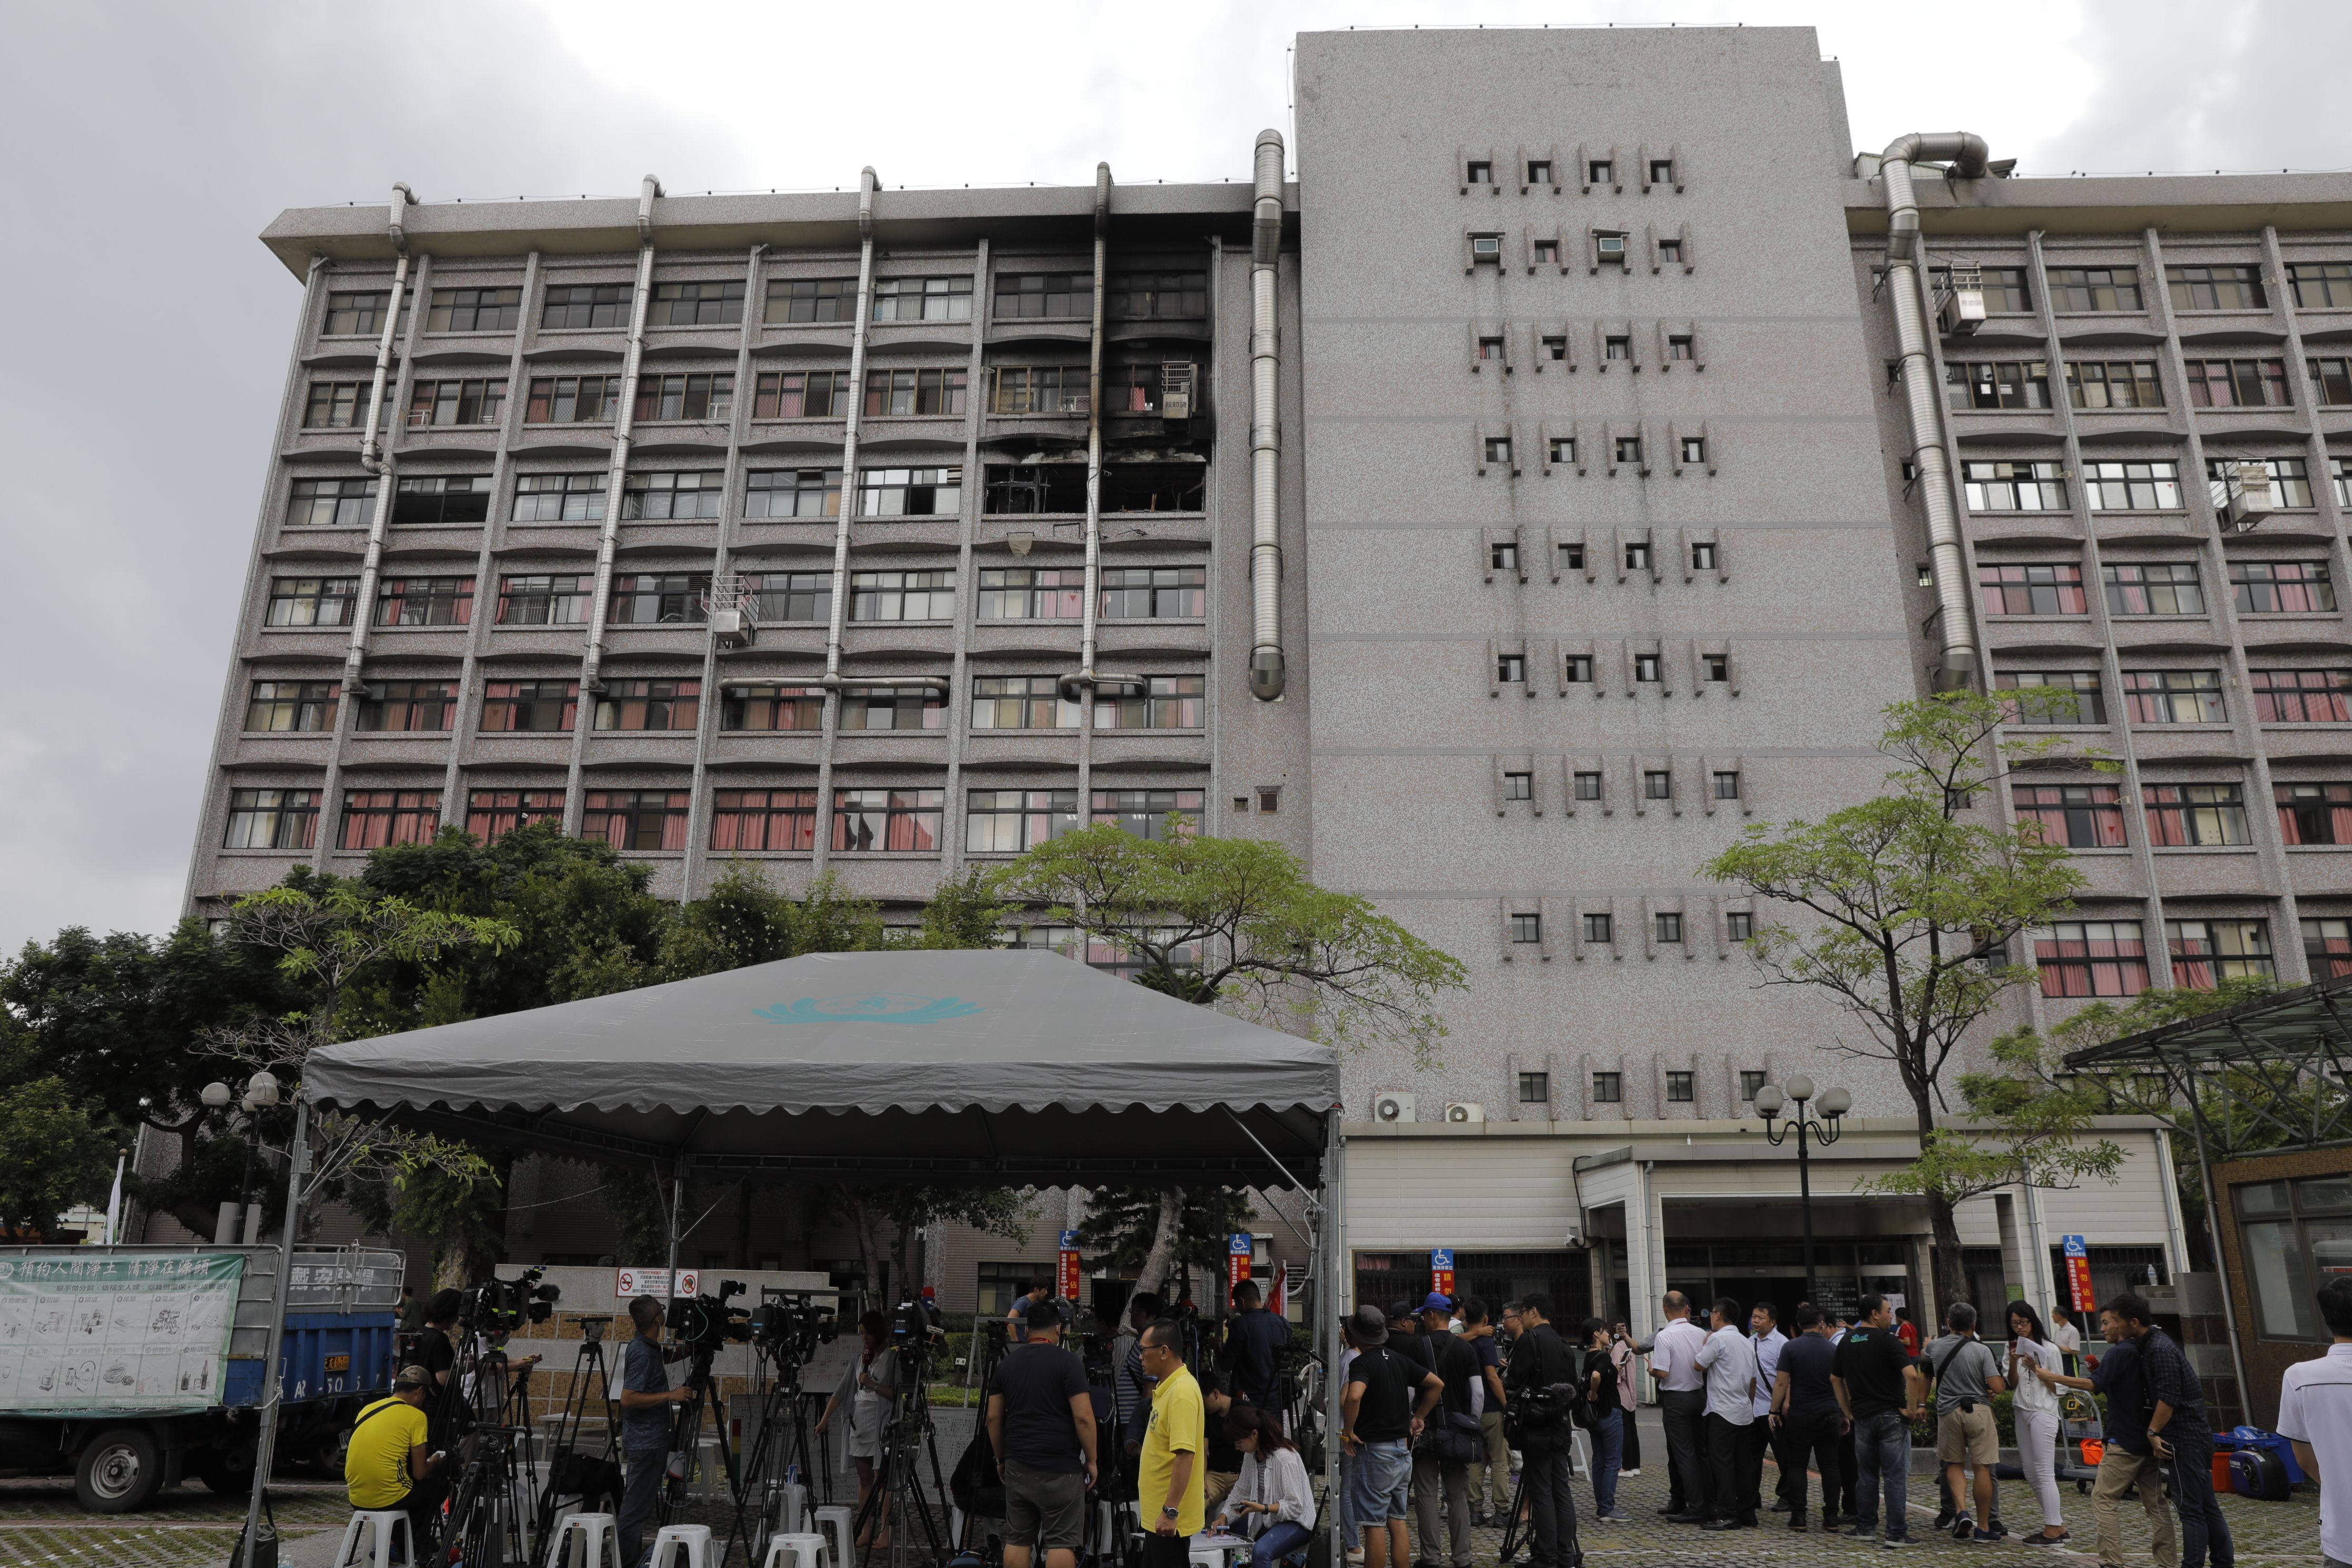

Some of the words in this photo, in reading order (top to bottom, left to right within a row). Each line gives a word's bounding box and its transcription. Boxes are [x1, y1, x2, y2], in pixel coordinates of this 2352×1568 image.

[19, 1260, 118, 1277] 預約人間淨土
[128, 1258, 211, 1276] 清淨在源頭
[1444, 1273, 1452, 1295] 請勿
[2077, 1260, 2093, 1310] 請勿佔用
